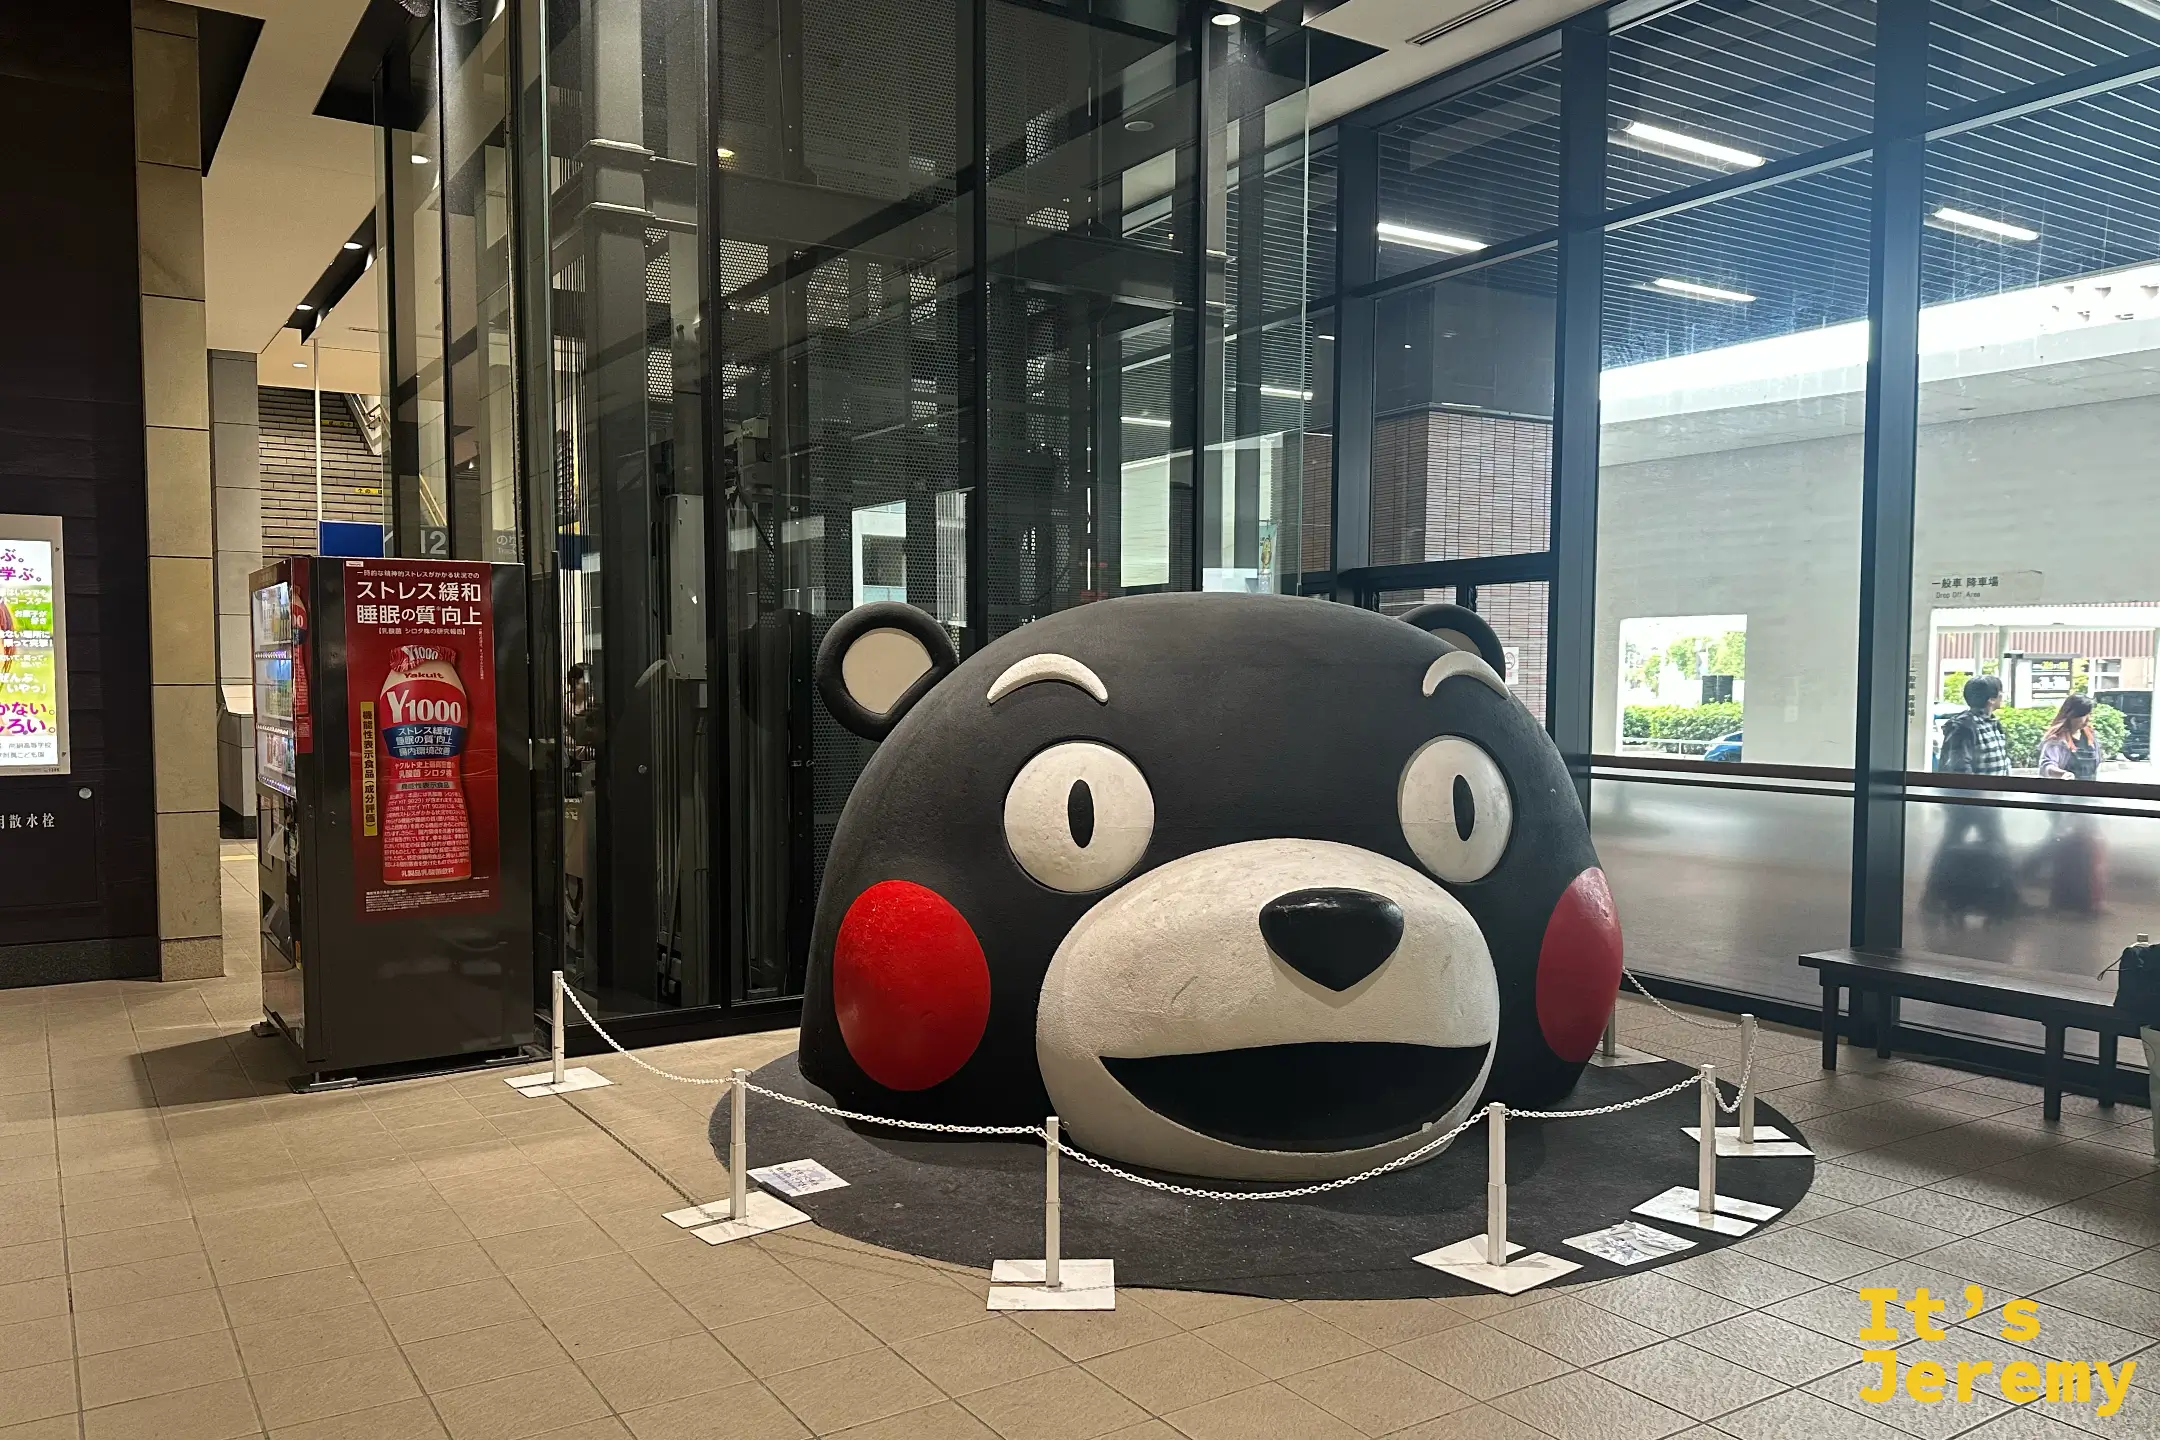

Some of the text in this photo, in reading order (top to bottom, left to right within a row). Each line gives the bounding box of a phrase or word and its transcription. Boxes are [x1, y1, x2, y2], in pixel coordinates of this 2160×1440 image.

[420, 529, 447, 555] 12
[356, 581, 482, 602] ストレス緩和
[401, 645, 438, 661] Y1000
[386, 689, 462, 724] Y1000
